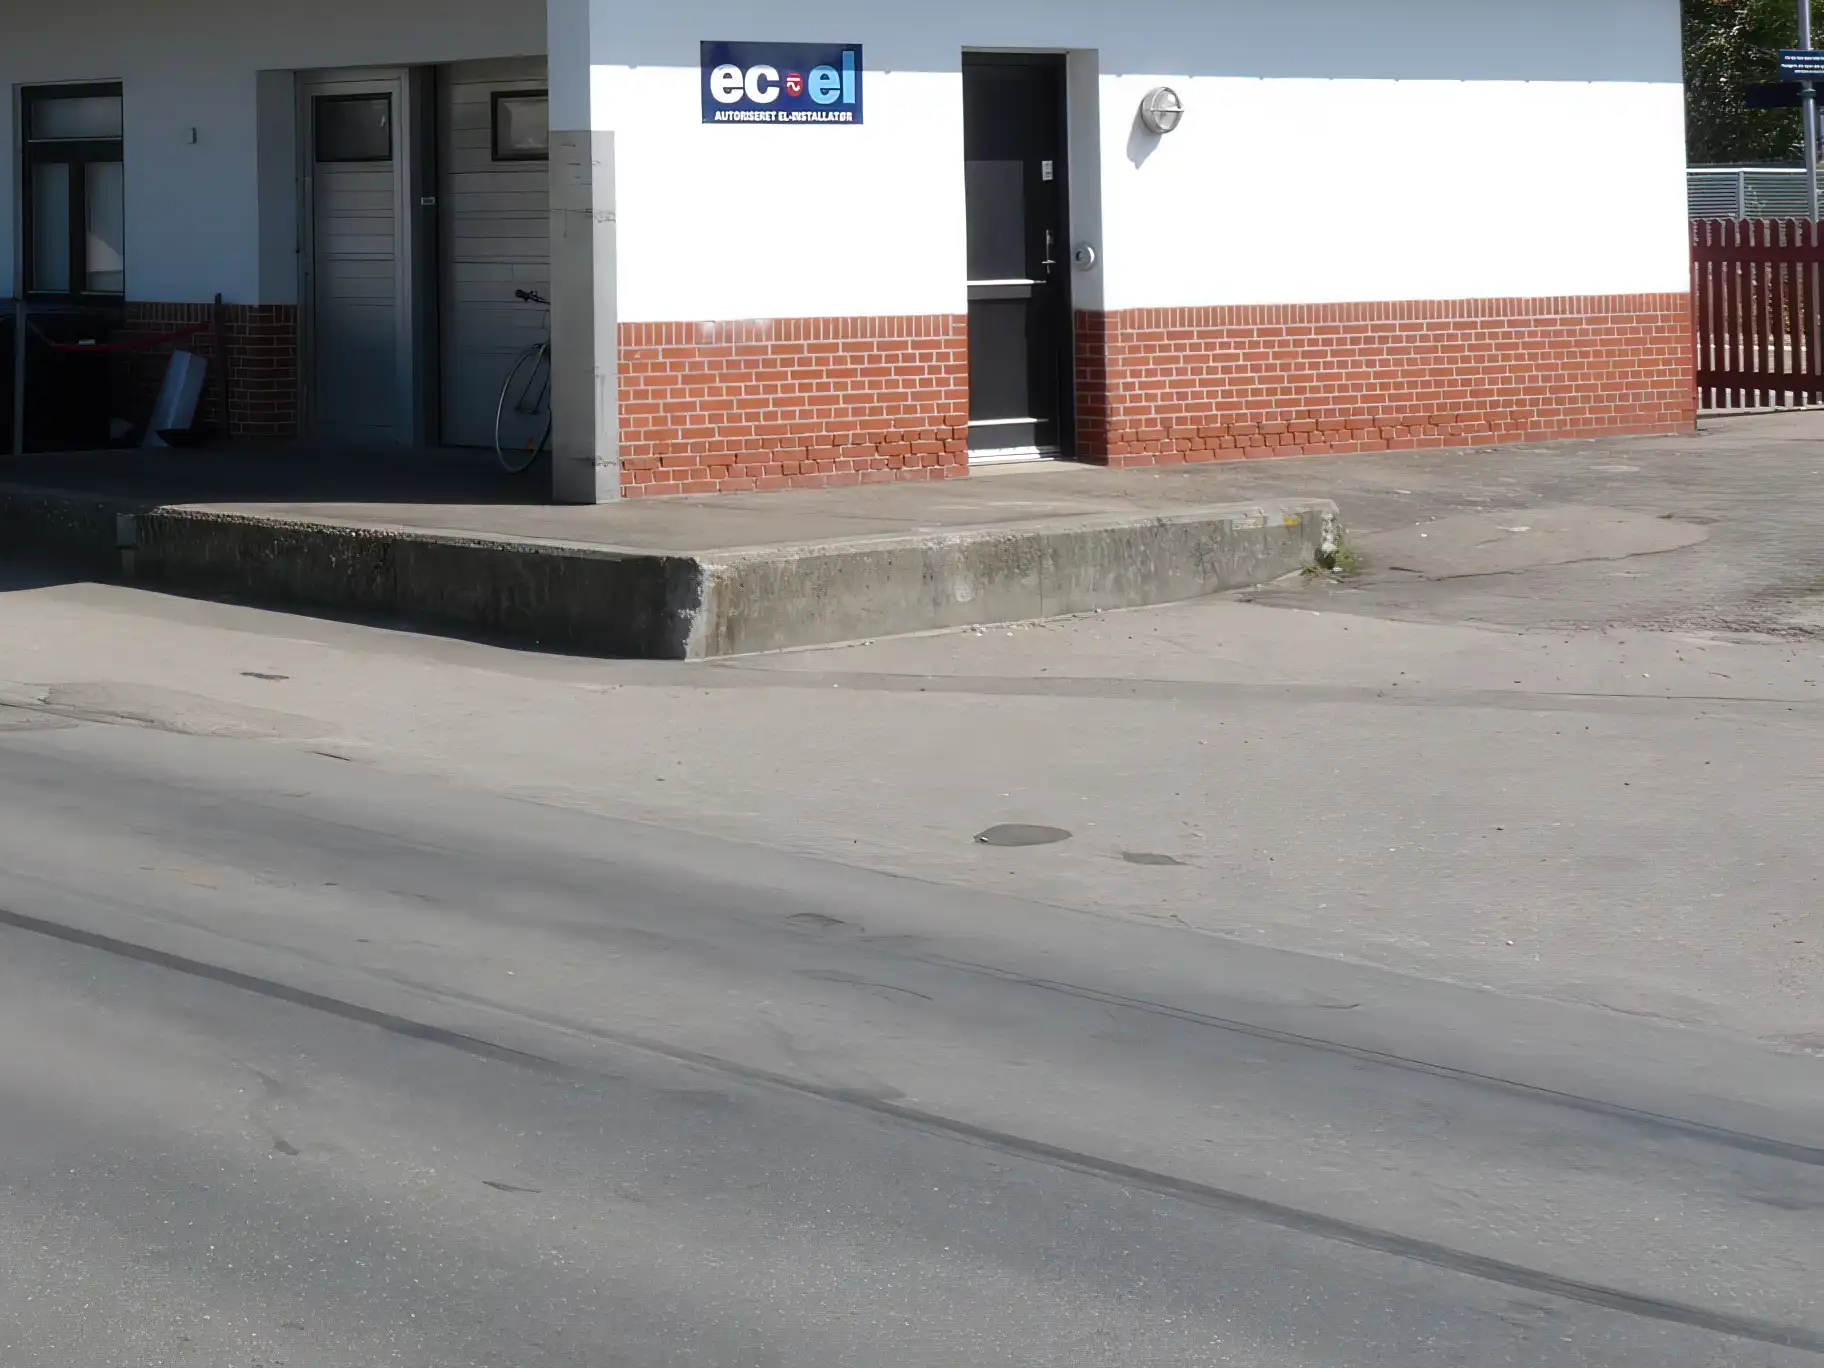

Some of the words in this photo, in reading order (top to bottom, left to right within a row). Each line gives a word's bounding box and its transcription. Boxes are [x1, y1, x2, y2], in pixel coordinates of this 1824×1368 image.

[710, 63, 780, 104] ec
[808, 50, 856, 105] el
[714, 110, 776, 122] AUTORISERET
